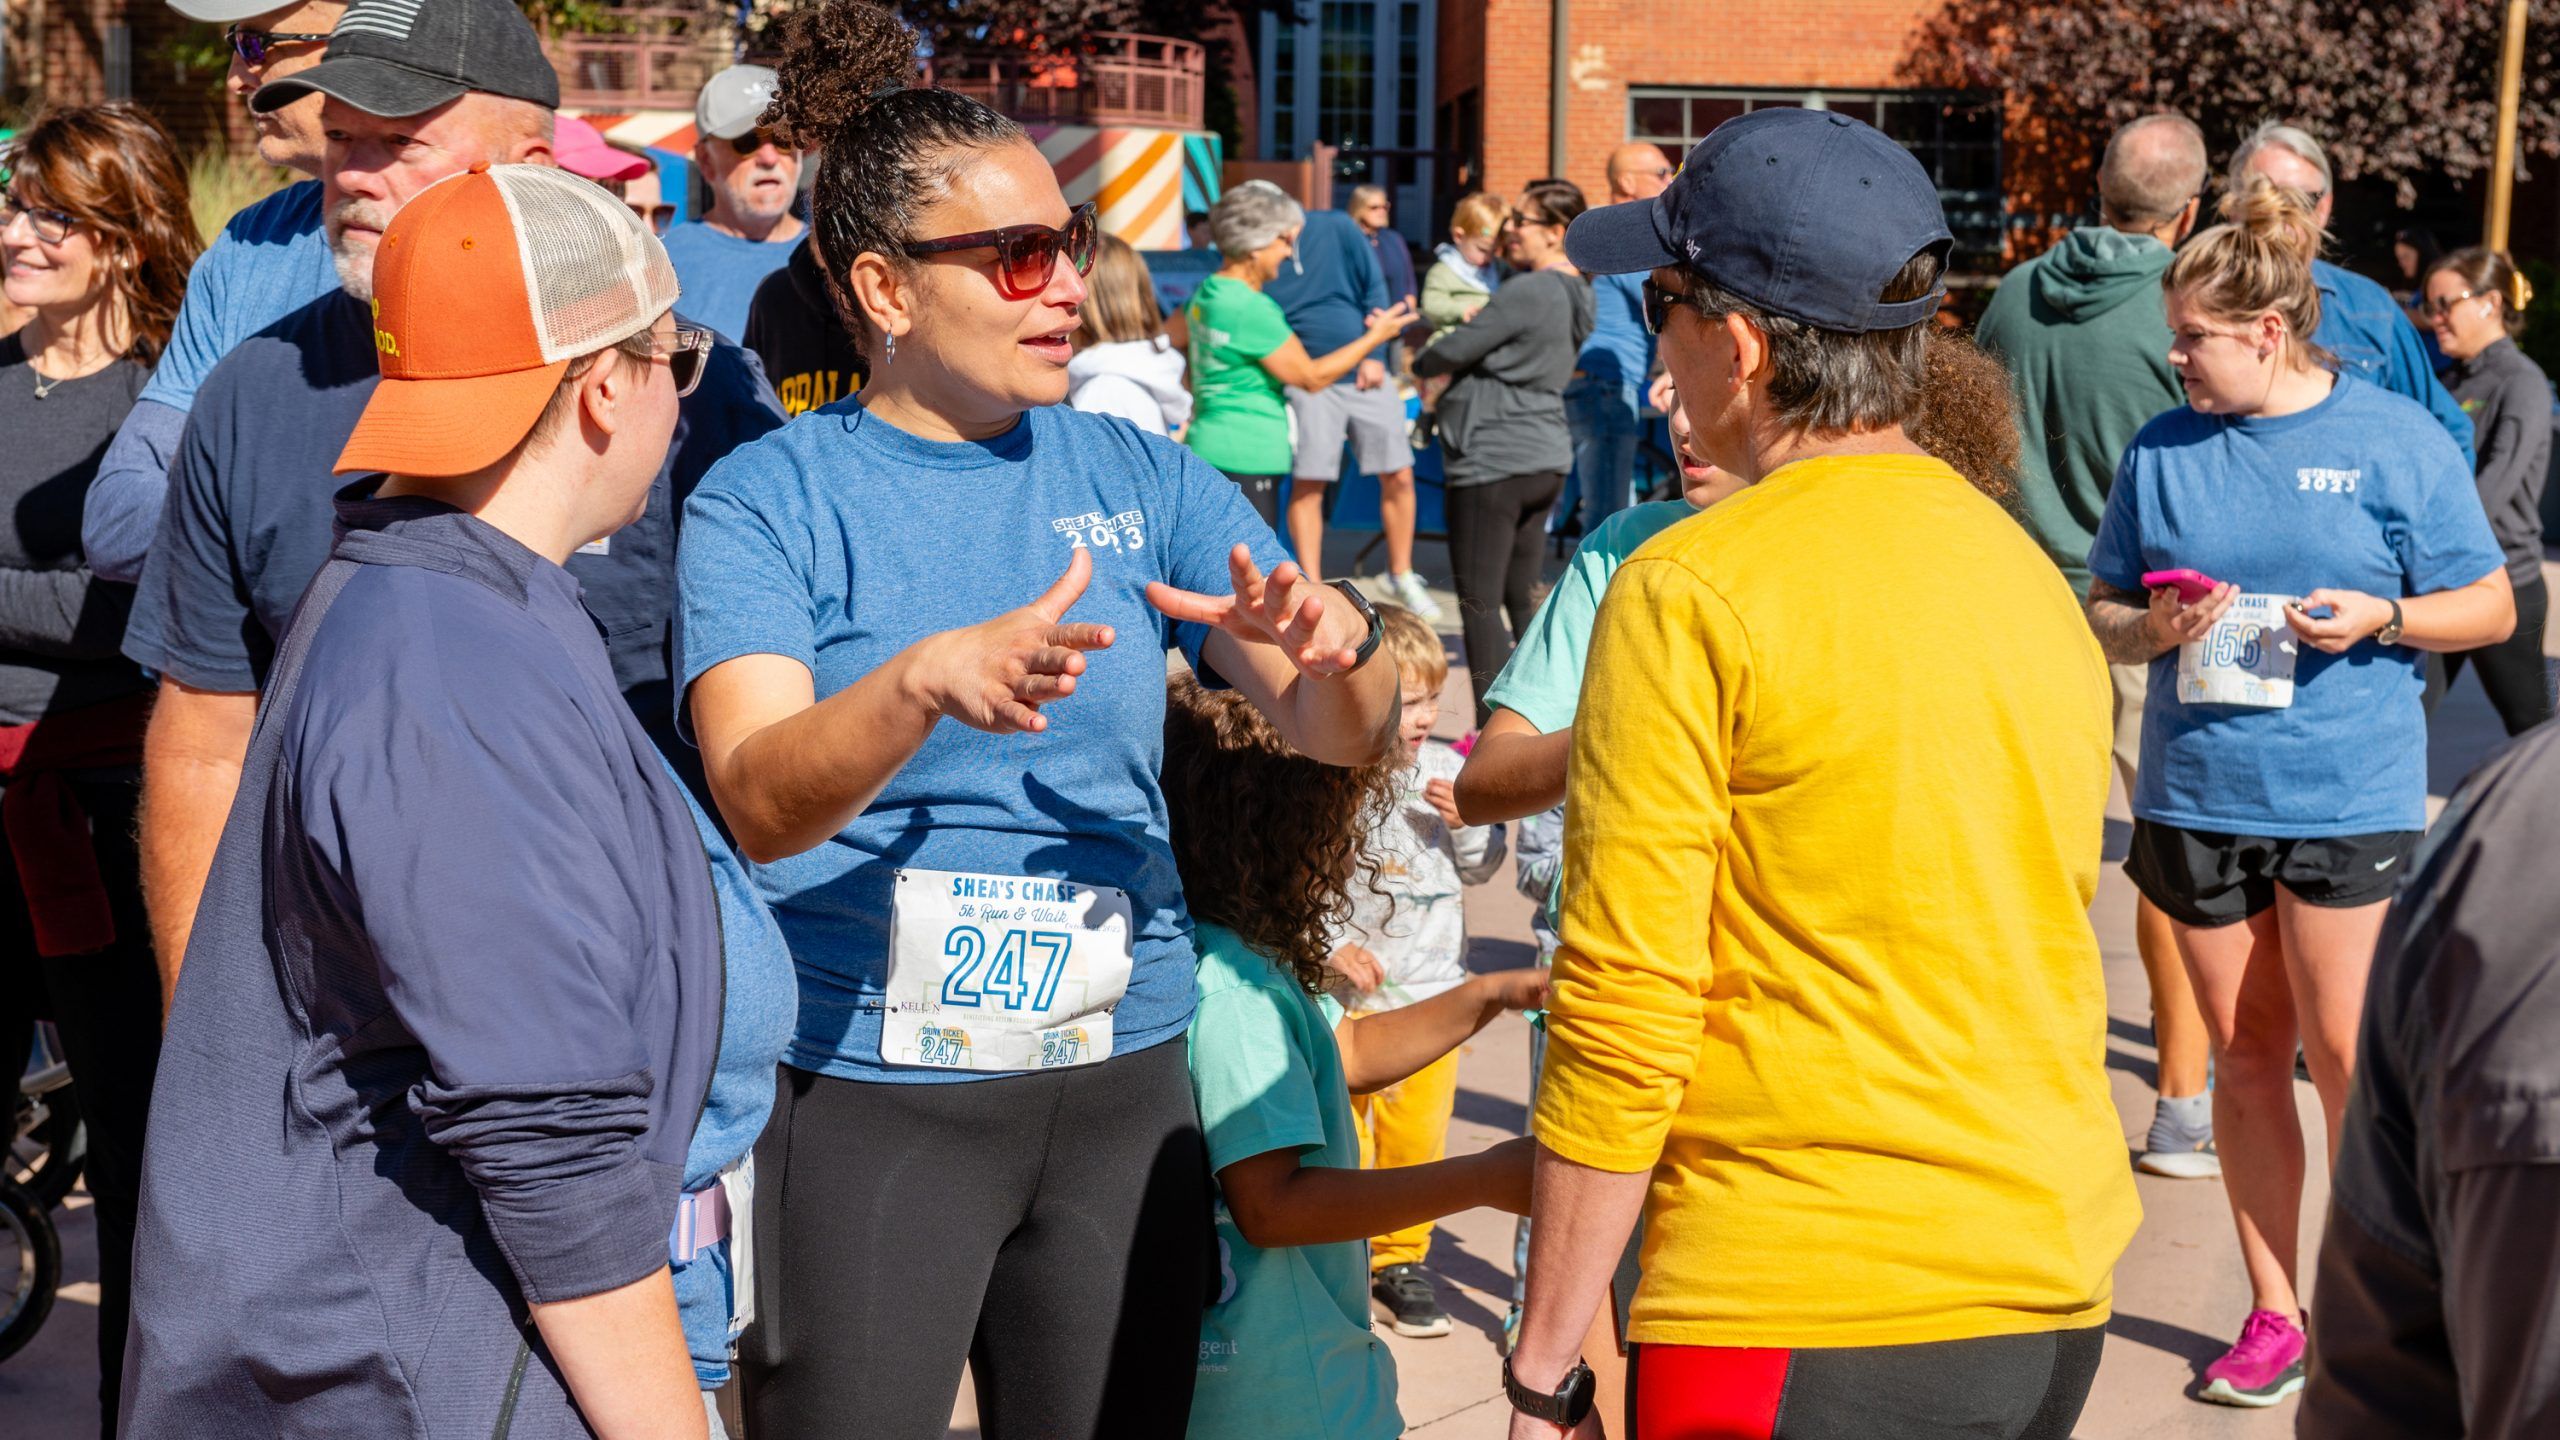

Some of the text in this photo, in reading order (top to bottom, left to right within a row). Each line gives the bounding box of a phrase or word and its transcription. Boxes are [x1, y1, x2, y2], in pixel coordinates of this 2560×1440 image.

[1102, 510, 1143, 532] HASE
[2201, 622, 2263, 669] 156
[952, 876, 1077, 904] SHEA'S CHASE
[980, 903, 1009, 923] Run
[1013, 906, 1028, 921] &
[1031, 907, 1069, 924] Walk
[941, 925, 1072, 1012] 247
[900, 1000, 942, 1015] KELLN
[922, 1026, 964, 1039] DRINK TICKET
[1043, 1027, 1078, 1041] DRINK TICKET
[920, 1035, 964, 1066] 247
[1041, 1037, 1080, 1067] 247
